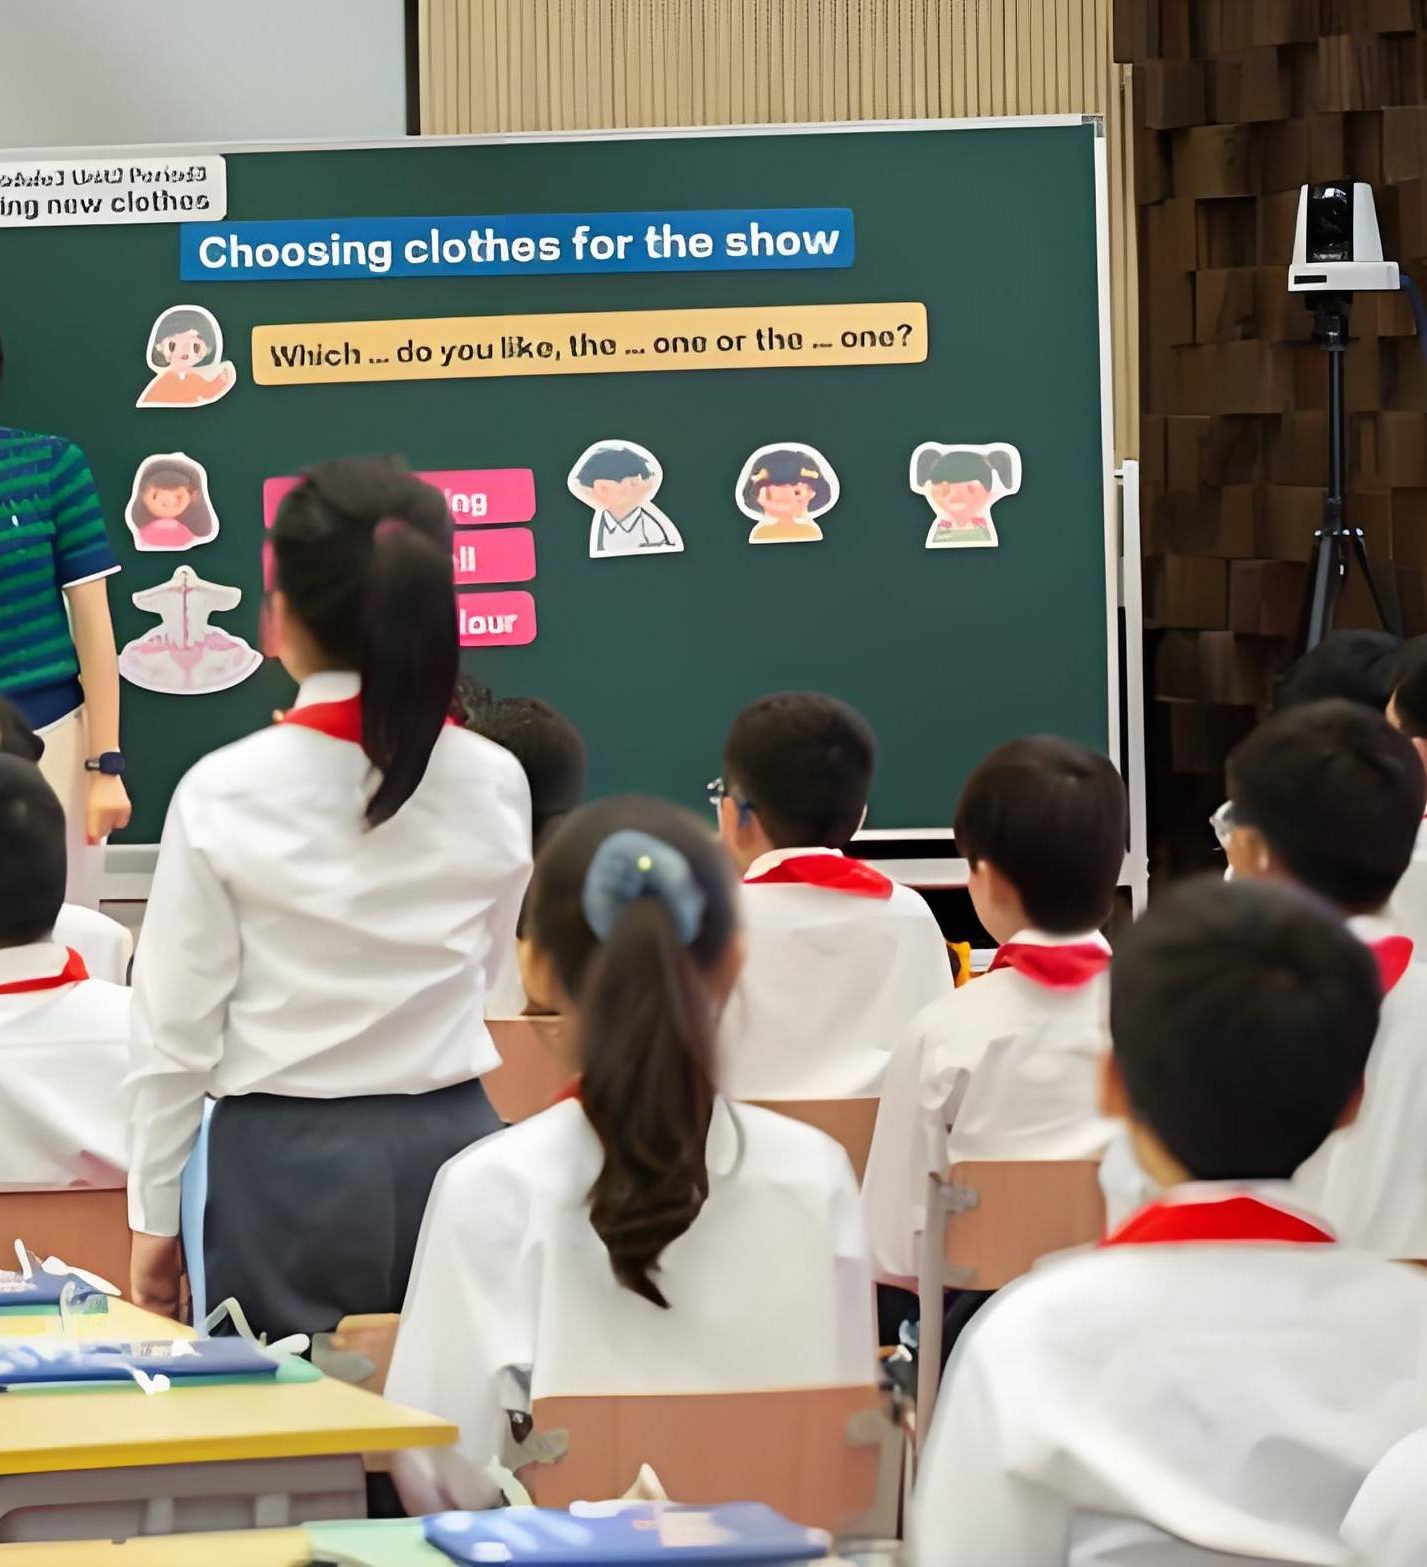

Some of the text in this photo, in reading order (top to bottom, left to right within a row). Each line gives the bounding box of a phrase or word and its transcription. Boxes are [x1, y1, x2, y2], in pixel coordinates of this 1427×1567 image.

[199, 221, 840, 273] Choosing clothes for the show
[269, 340, 361, 368] Which
[396, 338, 432, 363] do
[440, 343, 493, 367] you
[500, 334, 561, 362] like,
[716, 334, 747, 353] or
